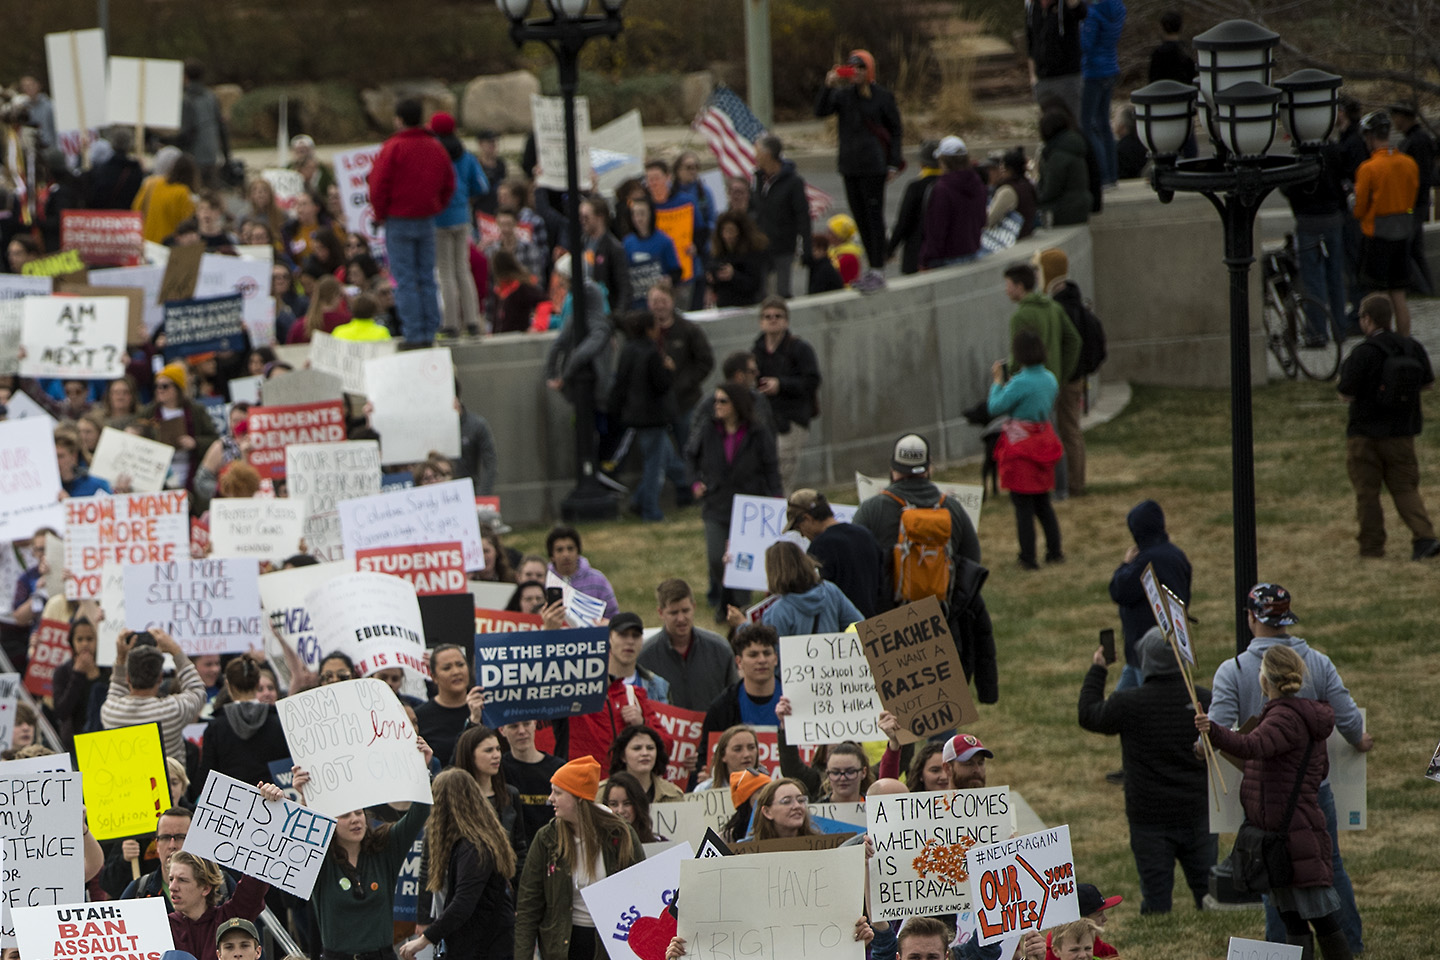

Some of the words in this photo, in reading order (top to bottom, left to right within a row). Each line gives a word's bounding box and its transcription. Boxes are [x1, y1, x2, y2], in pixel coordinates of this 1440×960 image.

[57, 304, 96, 326] AM
[67, 326, 84, 346] I
[249, 406, 343, 431] STUDENTS
[249, 425, 344, 449] DEMAND
[250, 451, 285, 464] GUN
[68, 499, 116, 524] HOW
[127, 490, 188, 519] MANY
[98, 519, 159, 543] MORE
[359, 549, 463, 573] STUDENTS
[146, 578, 235, 605] SILENCE
[355, 623, 421, 645] EDUCATION
[864, 618, 888, 638] AS
[865, 614, 947, 659] TEACHER
[373, 652, 388, 667] IS
[479, 646, 508, 661] WE
[510, 644, 543, 660] THE
[545, 641, 607, 658] PEOPLE
[806, 636, 819, 660] 6
[896, 649, 928, 669] WANT
[480, 657, 606, 688] DEMAND
[784, 664, 815, 685] 239
[820, 664, 854, 680] School
[880, 660, 952, 701] RAISE
[481, 688, 522, 705] GUN
[526, 680, 604, 700] REFORM
[810, 682, 834, 697] 438
[284, 687, 340, 732] ARM
[354, 680, 385, 712] US
[813, 699, 835, 716] 138
[894, 693, 924, 717] NOT
[911, 703, 955, 737] GUN
[288, 712, 364, 759] WITH
[367, 710, 413, 747] love
[301, 754, 356, 802] NOT
[205, 777, 273, 826] LETS
[281, 802, 339, 848] YEET
[875, 800, 888, 824] A
[896, 795, 945, 822] TIME
[950, 792, 1009, 819] COMES
[196, 805, 245, 840] THEM
[250, 828, 294, 858] OUT
[288, 844, 324, 868] OF
[873, 828, 928, 853] WHEN
[932, 824, 1000, 848] SILENCE
[975, 831, 1059, 865] #NEVERAGAIN
[213, 841, 301, 889] OFFICE
[877, 855, 898, 876] IS
[1043, 862, 1074, 886] YOUR
[695, 866, 761, 924] I
[767, 865, 830, 909] HAVE
[879, 879, 966, 905] BETRAYAL
[979, 863, 1022, 911] OUR
[56, 906, 123, 922] UTAH:
[914, 904, 945, 916] LUTHER
[977, 899, 1038, 940] LIVES
[57, 919, 128, 939] BAN
[612, 904, 642, 942] LESS
[53, 935, 139, 957] ASSAULT
[793, 920, 843, 957] TO
